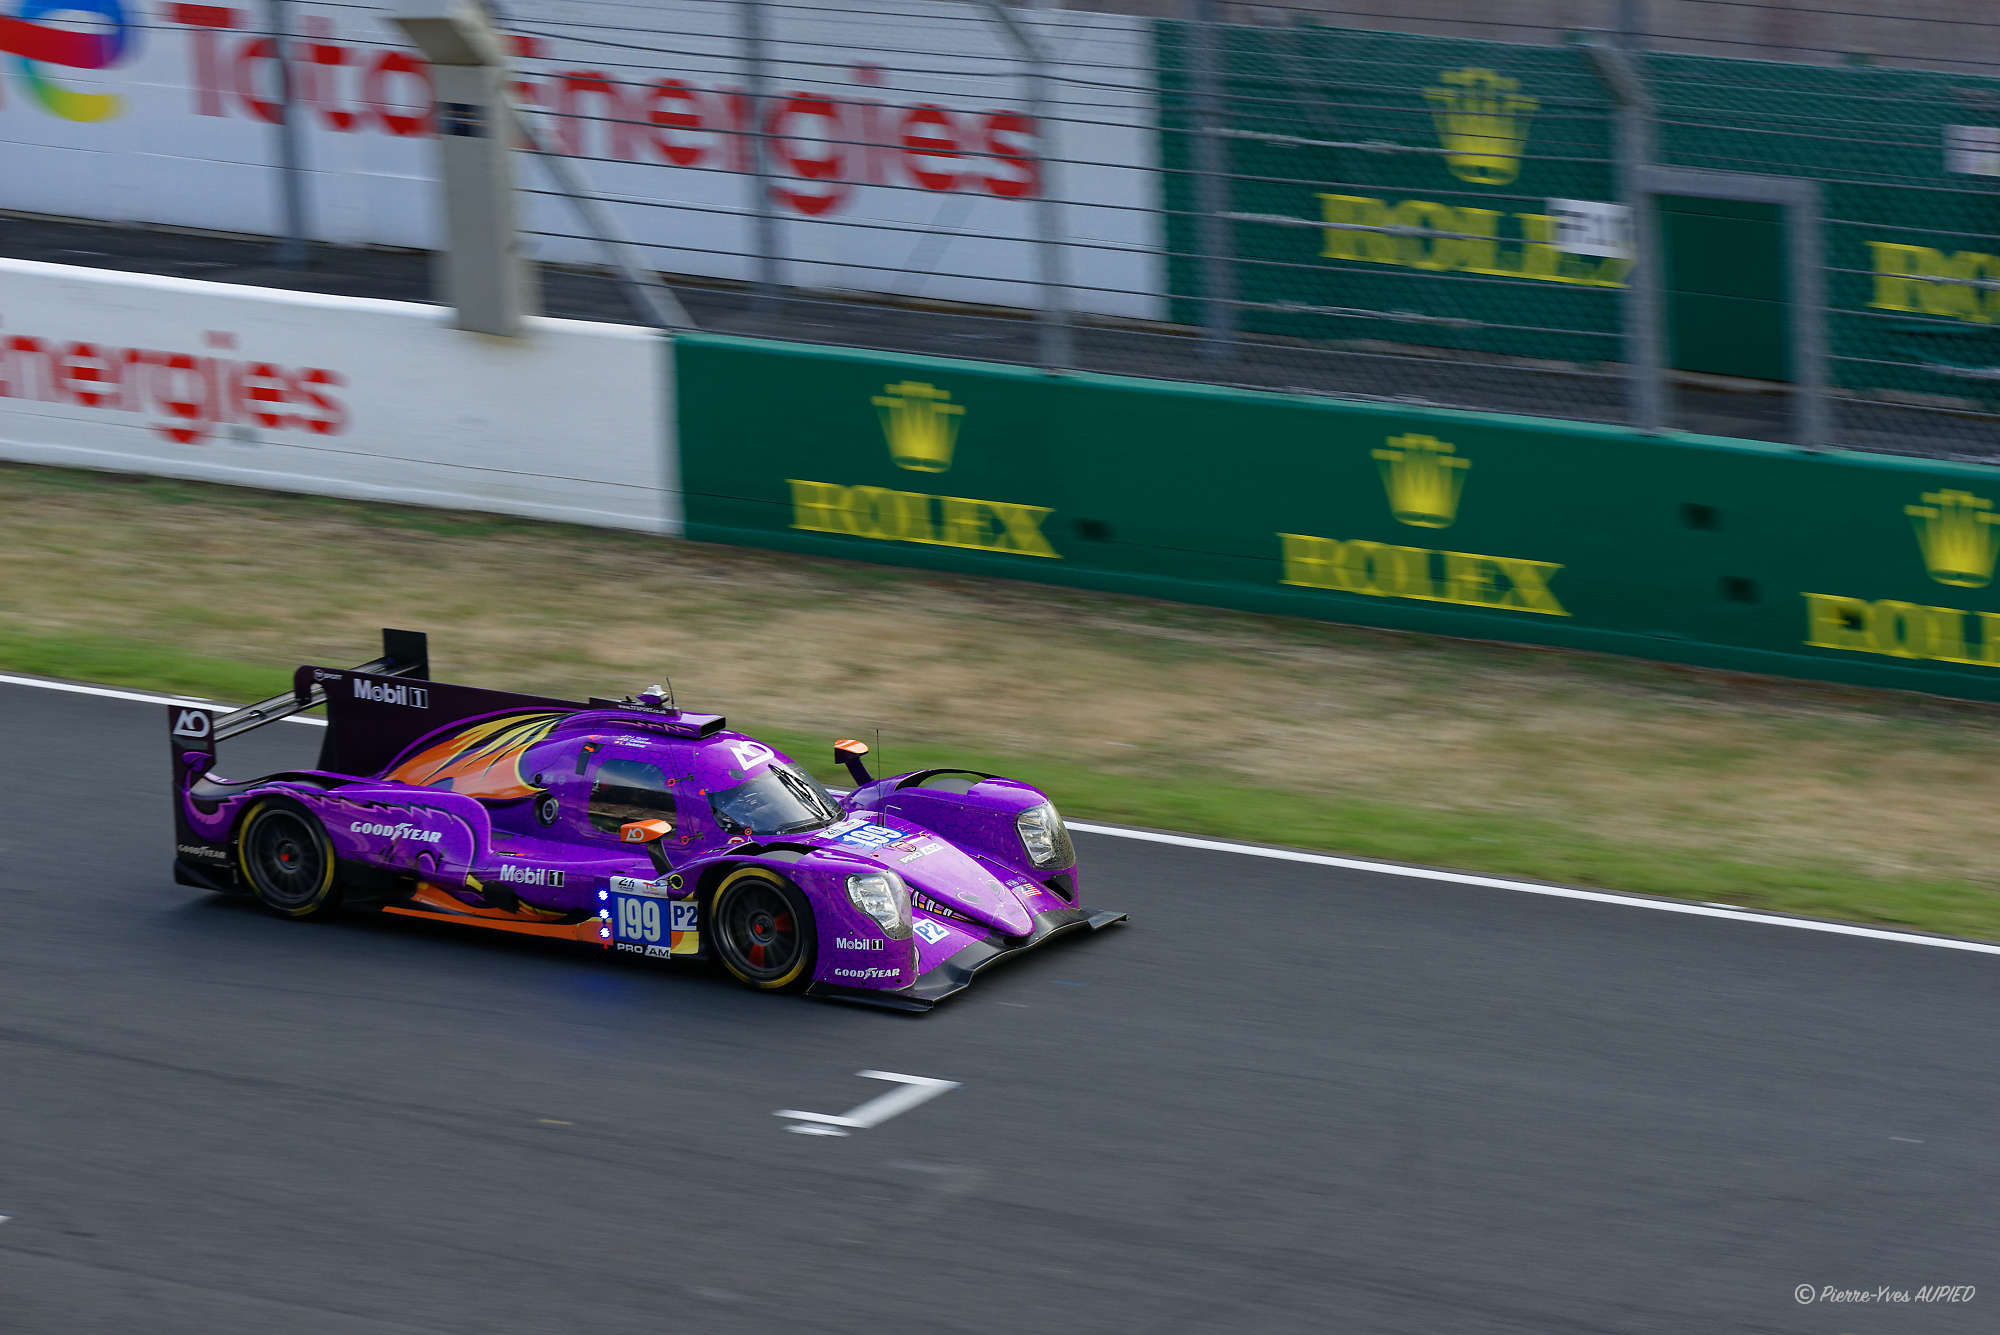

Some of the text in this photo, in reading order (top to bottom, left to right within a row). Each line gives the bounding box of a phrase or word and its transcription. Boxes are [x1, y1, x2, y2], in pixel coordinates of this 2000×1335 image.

[0, 312, 348, 445] nergies
[785, 478, 1063, 559] ROLEX
[1276, 532, 1572, 616] ROLEX
[353, 679, 428, 709] Mobil 1
[350, 821, 442, 843] GOODYEAR
[843, 825, 903, 848] 199
[177, 844, 227, 859] GOODYEAR
[500, 864, 565, 887] Mobil 1
[617, 897, 661, 942] 199
[673, 905, 697, 927] P2
[915, 922, 945, 941] P2
[617, 943, 670, 957] PRO AM
[836, 937, 884, 951] Mobil 1
[834, 967, 900, 980] GOODYEAR
